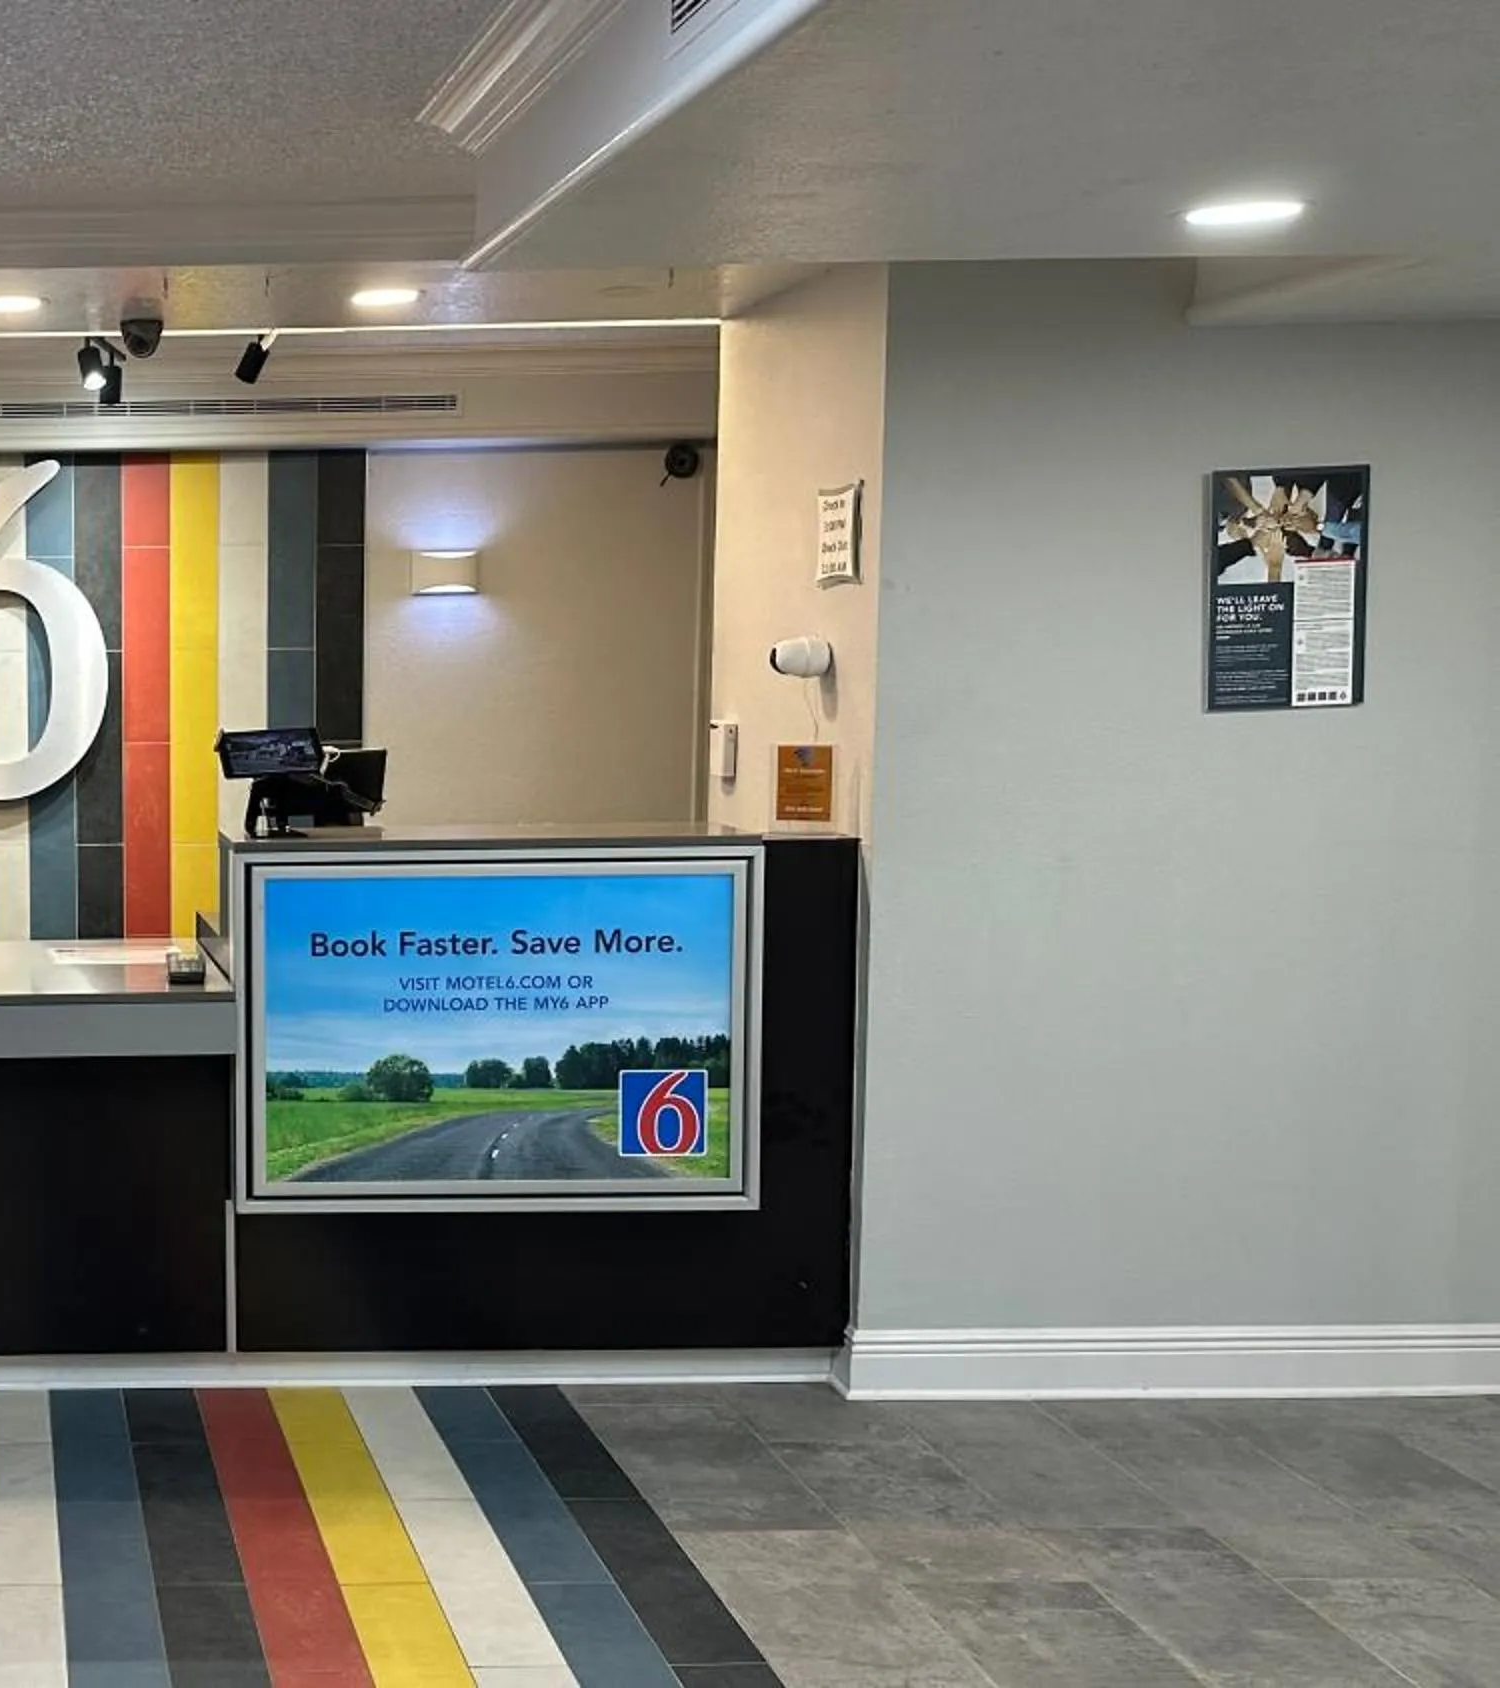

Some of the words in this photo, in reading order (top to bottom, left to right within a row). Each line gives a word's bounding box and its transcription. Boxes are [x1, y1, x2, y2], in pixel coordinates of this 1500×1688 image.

[1216, 605, 1235, 613] THE
[1237, 604, 1267, 613] LIGHT
[310, 931, 387, 957] Book
[400, 931, 498, 956] Faster.
[511, 929, 581, 955] Save
[595, 928, 683, 954] More.
[400, 977, 440, 991] VISIT
[445, 975, 561, 990] MOTEL6.COM
[567, 975, 593, 989] OR
[383, 997, 489, 1013] DOWNLOAD
[494, 997, 527, 1011] THE
[533, 997, 569, 1011] MY6
[575, 995, 609, 1010] APP
[637, 1069, 700, 1156] 6
